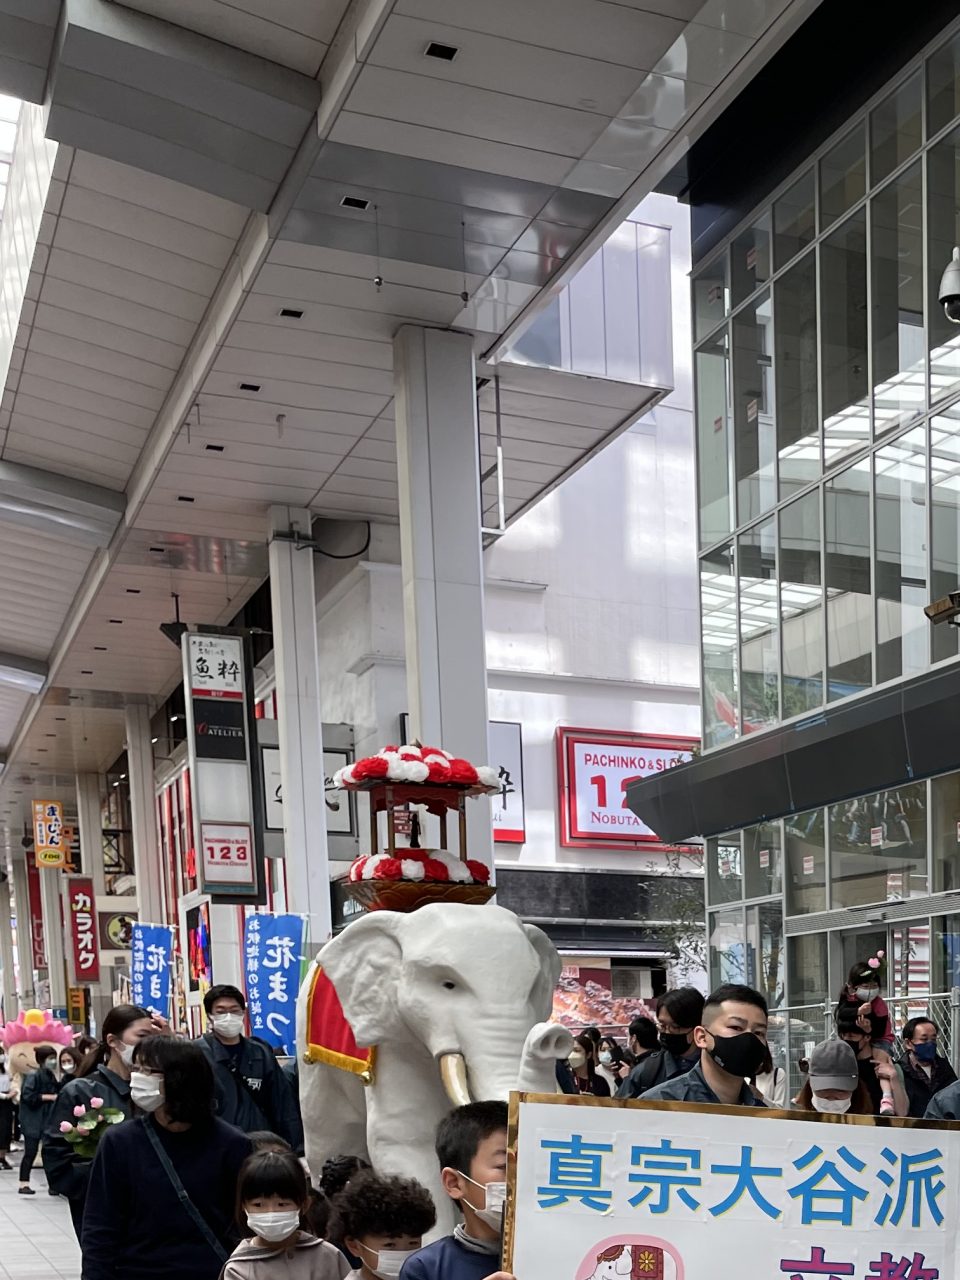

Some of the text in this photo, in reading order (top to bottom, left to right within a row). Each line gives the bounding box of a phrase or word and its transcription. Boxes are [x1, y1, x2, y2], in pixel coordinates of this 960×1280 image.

[208, 729, 243, 738] ATELIER
[584, 753, 646, 769] PACHINKO
[647, 761, 654, 770] &
[74, 892, 95, 969] カラオケ
[537, 1134, 947, 1229] 真宗大谷派
